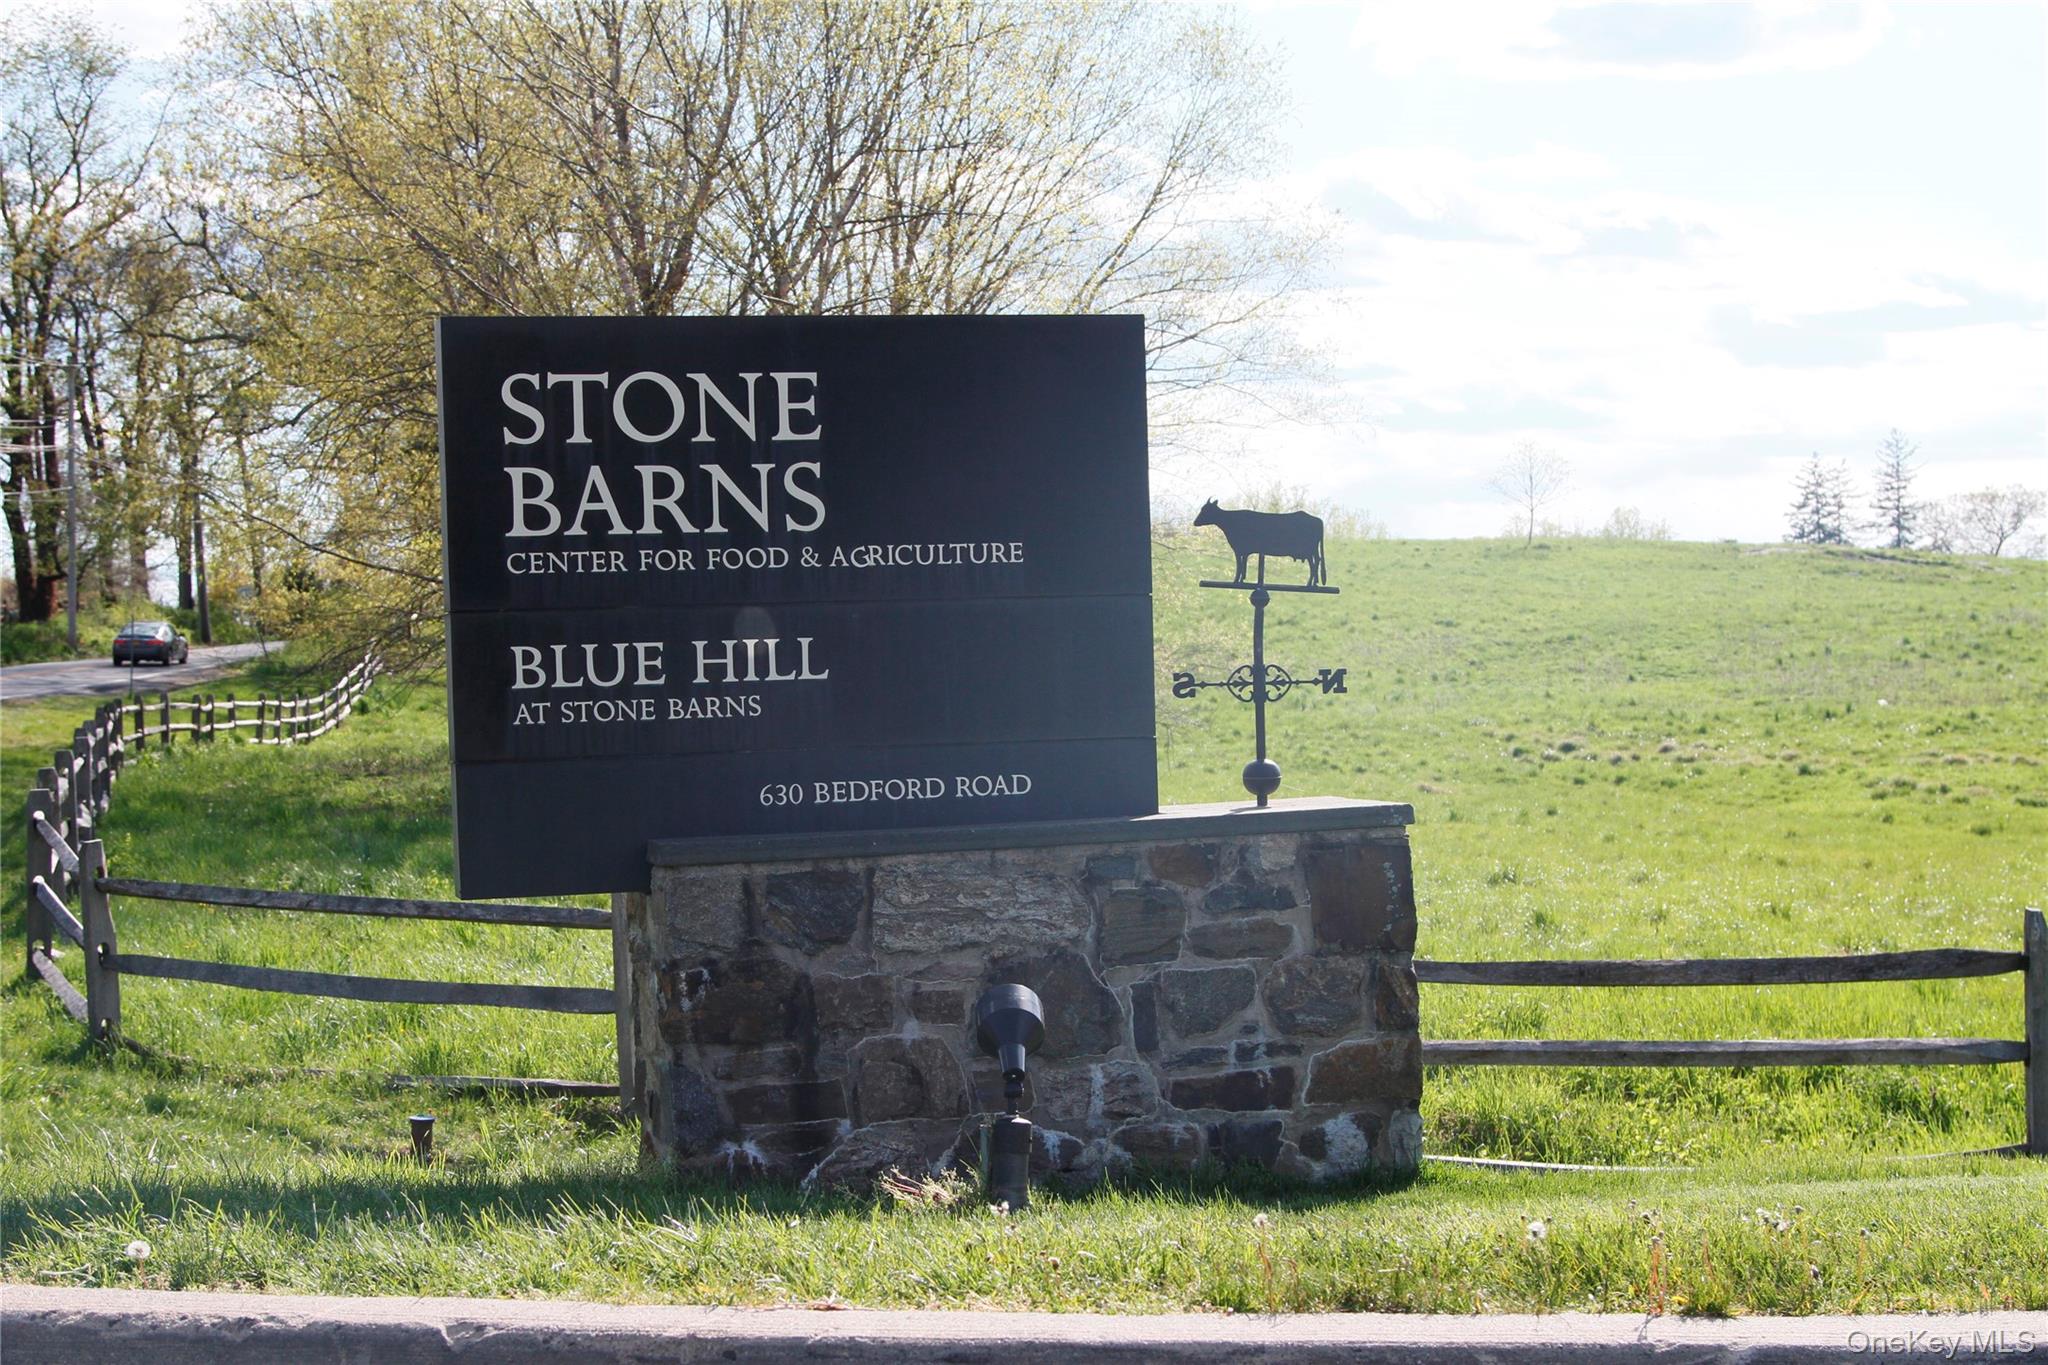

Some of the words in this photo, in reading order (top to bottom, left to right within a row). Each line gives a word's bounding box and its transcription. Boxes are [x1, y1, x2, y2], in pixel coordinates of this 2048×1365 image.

[501, 371, 822, 445] STONE
[503, 461, 826, 537] BARNS
[506, 550, 628, 575] CENTER
[638, 549, 696, 572] FOR
[706, 547, 789, 570] FOOD
[800, 546, 822, 568] &
[829, 541, 1024, 568] AGRICULTURE
[510, 641, 666, 689] BLUE
[691, 637, 830, 684] HILL
[513, 701, 551, 725] AT
[560, 699, 656, 723] STONE
[667, 695, 762, 720] BARNS
[759, 783, 804, 806] 630
[813, 777, 946, 804] BEDFORD
[955, 774, 1033, 798] ROAD
